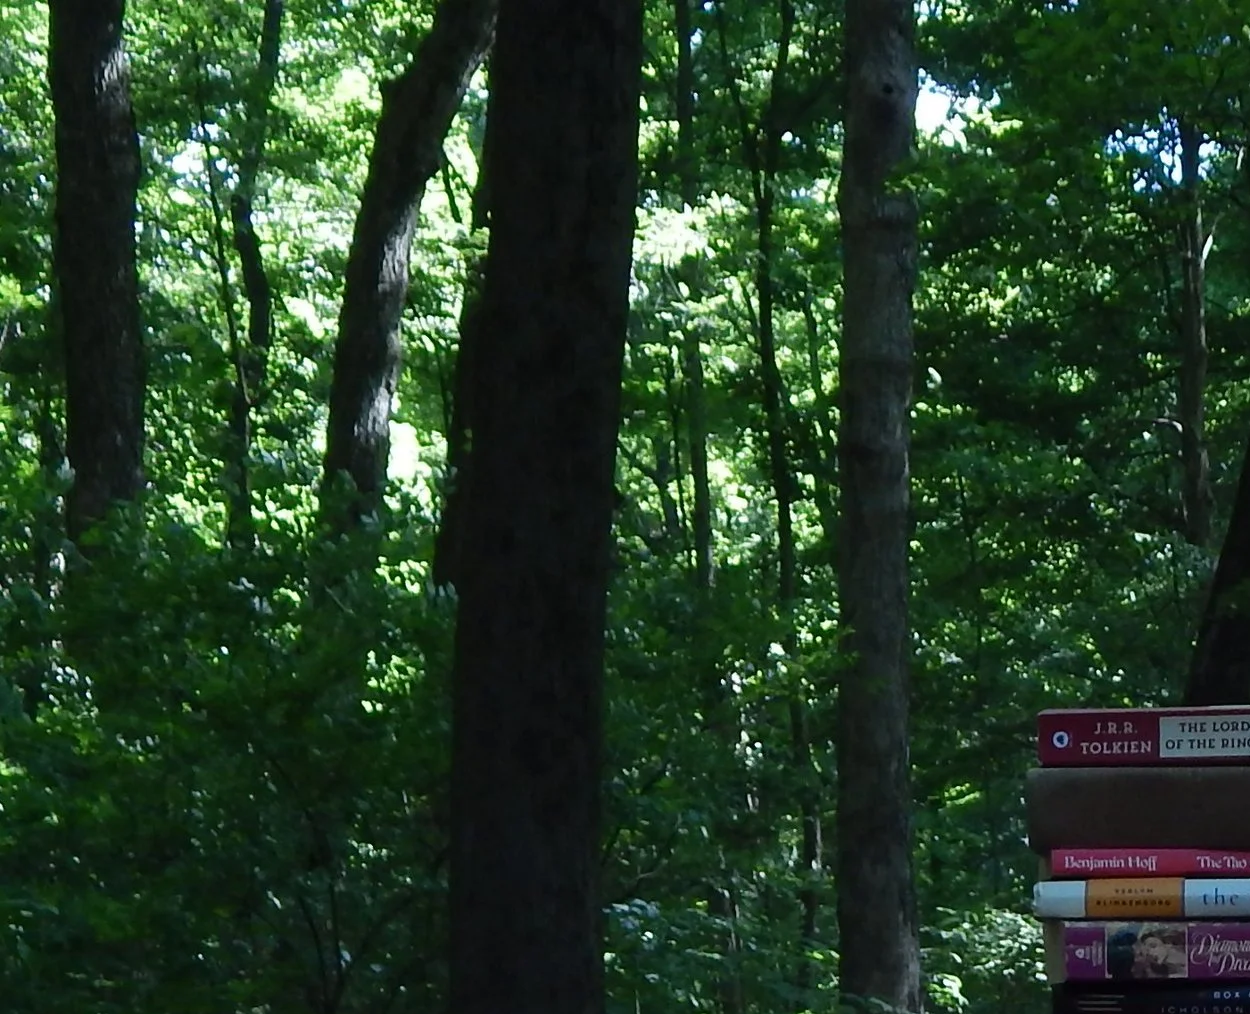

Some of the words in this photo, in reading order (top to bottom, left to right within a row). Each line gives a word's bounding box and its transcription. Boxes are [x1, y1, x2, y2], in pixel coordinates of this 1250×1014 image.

[1094, 721, 1138, 735] J.R.R.
[1179, 722, 1207, 733] THE
[1212, 721, 1250, 733] LORD
[1080, 740, 1152, 755] TOLKIEN
[1165, 739, 1183, 750] OF
[1188, 738, 1215, 750] THE
[1064, 855, 1125, 873] Benjamin
[1128, 855, 1158, 872] Hoff
[1197, 855, 1223, 869] The
[1202, 887, 1239, 905] the
[1213, 991, 1241, 1000] BOX
